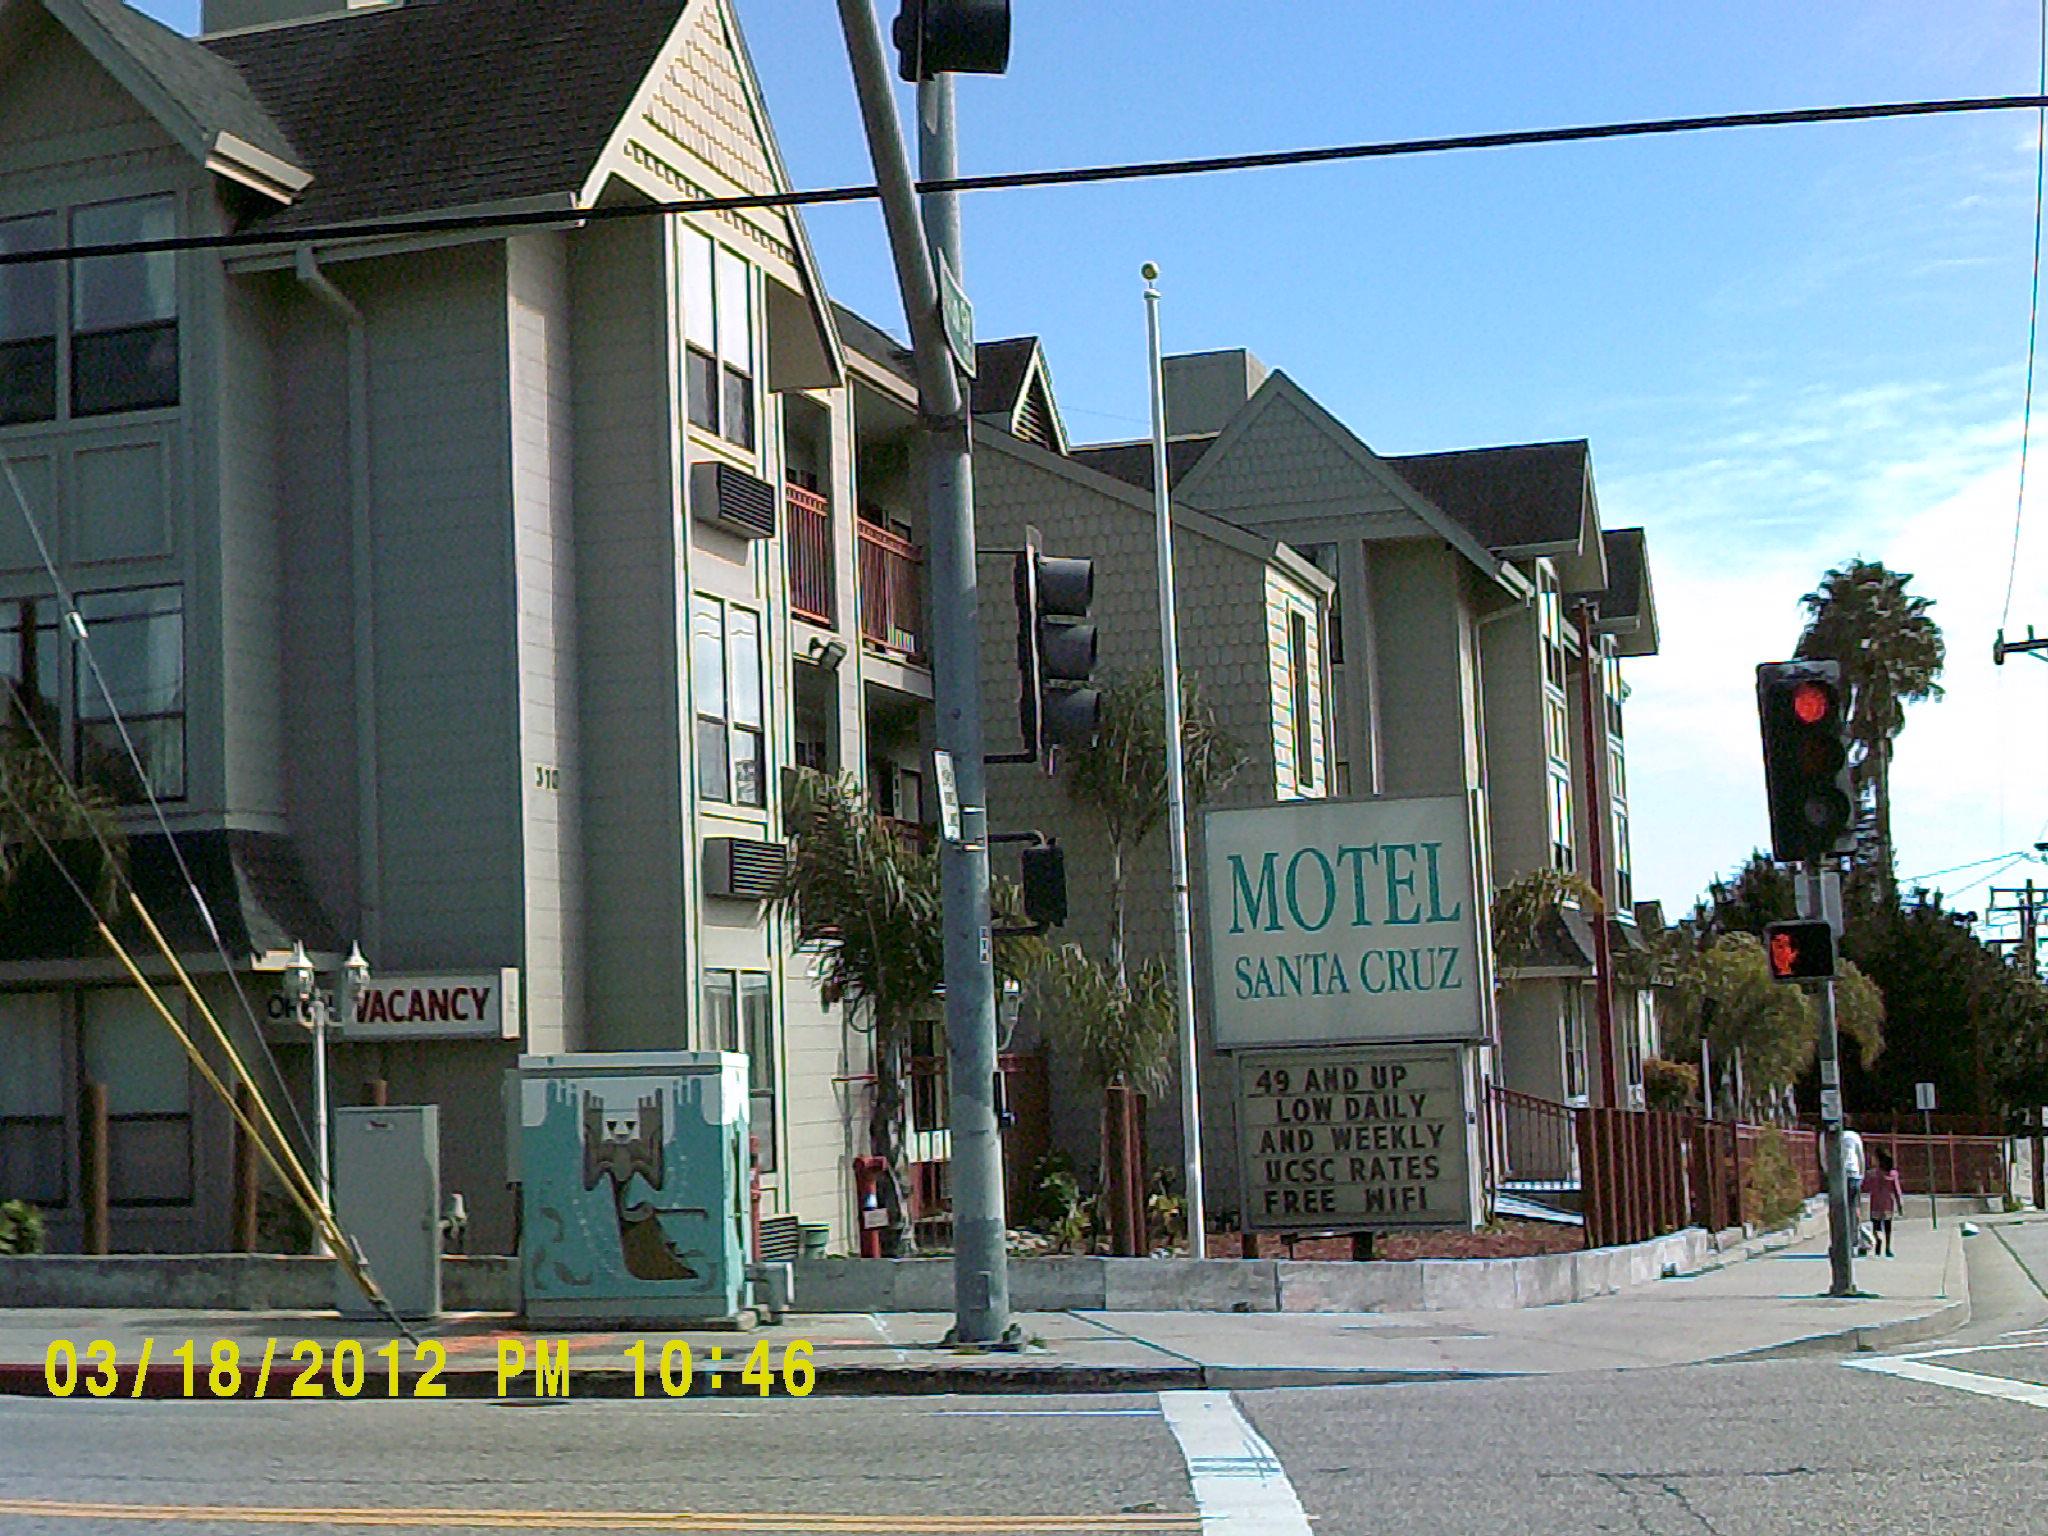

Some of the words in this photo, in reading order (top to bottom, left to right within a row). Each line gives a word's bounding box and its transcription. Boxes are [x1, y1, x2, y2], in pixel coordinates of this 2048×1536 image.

[1227, 843, 1461, 933] MOTEL
[1236, 952, 1350, 1000] SANTA
[1360, 948, 1462, 993] CRUZ
[356, 986, 490, 1023] VACANCY
[1256, 1070, 1289, 1093] 49
[1305, 1068, 1359, 1092] AND
[1370, 1066, 1407, 1089] UP
[1276, 1097, 1332, 1123] LOW
[1345, 1094, 1425, 1121] DAILY
[1261, 1129, 1314, 1154] AND
[1330, 1124, 1444, 1151] WEEKLY
[1266, 1158, 1335, 1183] UCSC
[1350, 1155, 1440, 1182] RATES
[1264, 1189, 1335, 1214] FREE
[1364, 1186, 1428, 1212] WIFI
